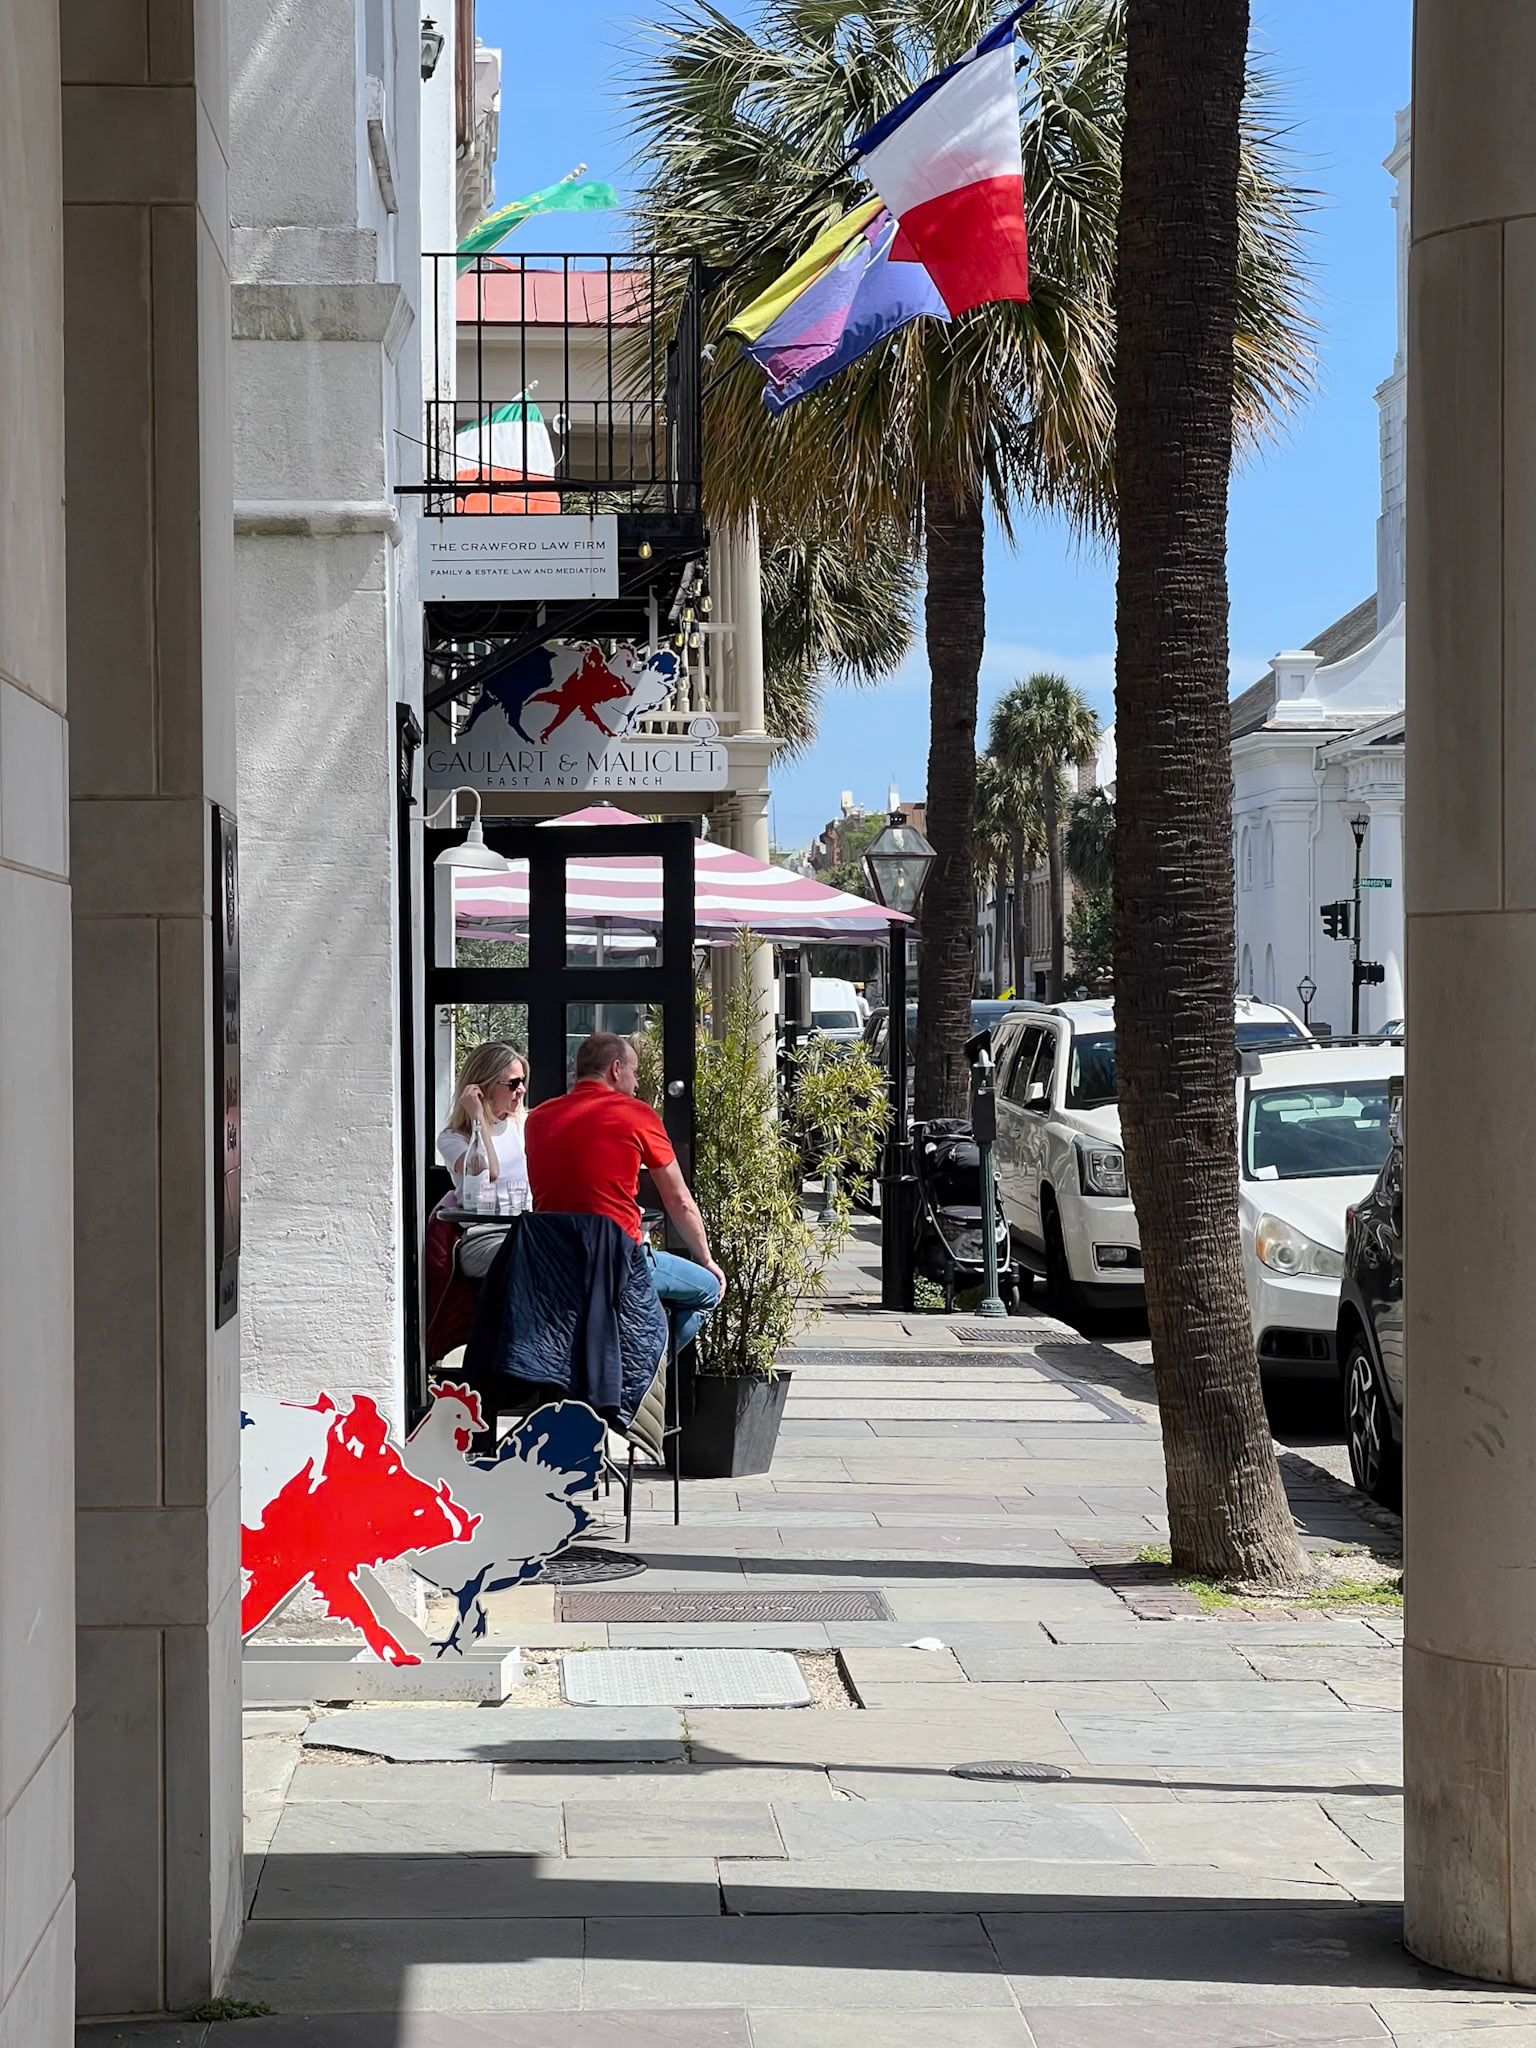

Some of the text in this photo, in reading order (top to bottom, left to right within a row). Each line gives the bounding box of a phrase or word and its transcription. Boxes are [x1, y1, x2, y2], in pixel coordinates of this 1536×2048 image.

[430, 541, 606, 551] THE CRAWFORD LAW FIRM
[428, 750, 549, 773] GAULART
[559, 754, 578, 772] &
[487, 777, 662, 785] FAST AND FRENCH
[1362, 879, 1385, 887] Meeting
